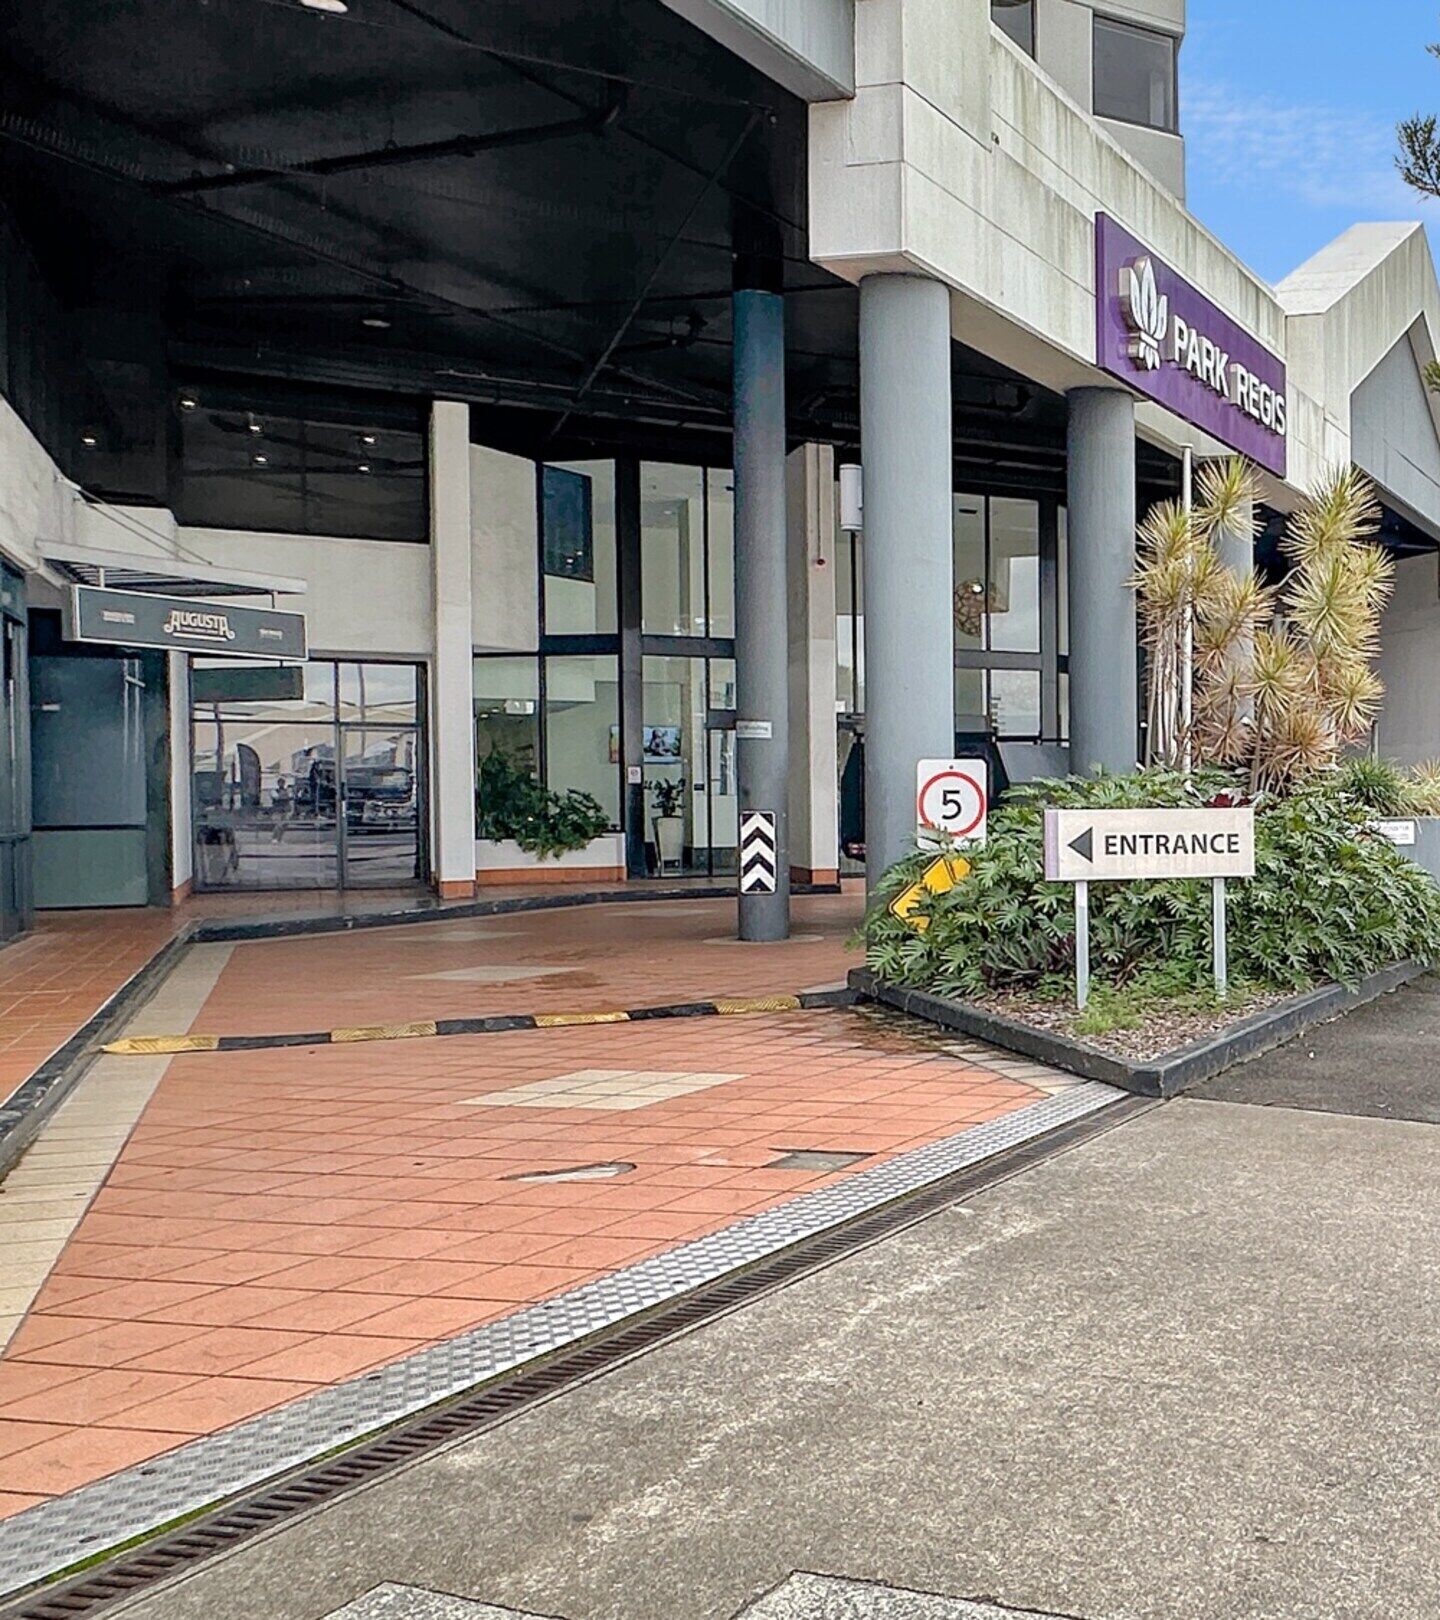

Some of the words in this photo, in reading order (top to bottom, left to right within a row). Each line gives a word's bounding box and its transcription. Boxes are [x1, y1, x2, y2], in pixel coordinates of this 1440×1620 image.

[1174, 315, 1230, 398] PARK
[1236, 364, 1287, 436] REGIS
[163, 609, 236, 640] AUGUSTA
[941, 789, 962, 820] 5
[1104, 832, 1240, 856] ENTRANCE
